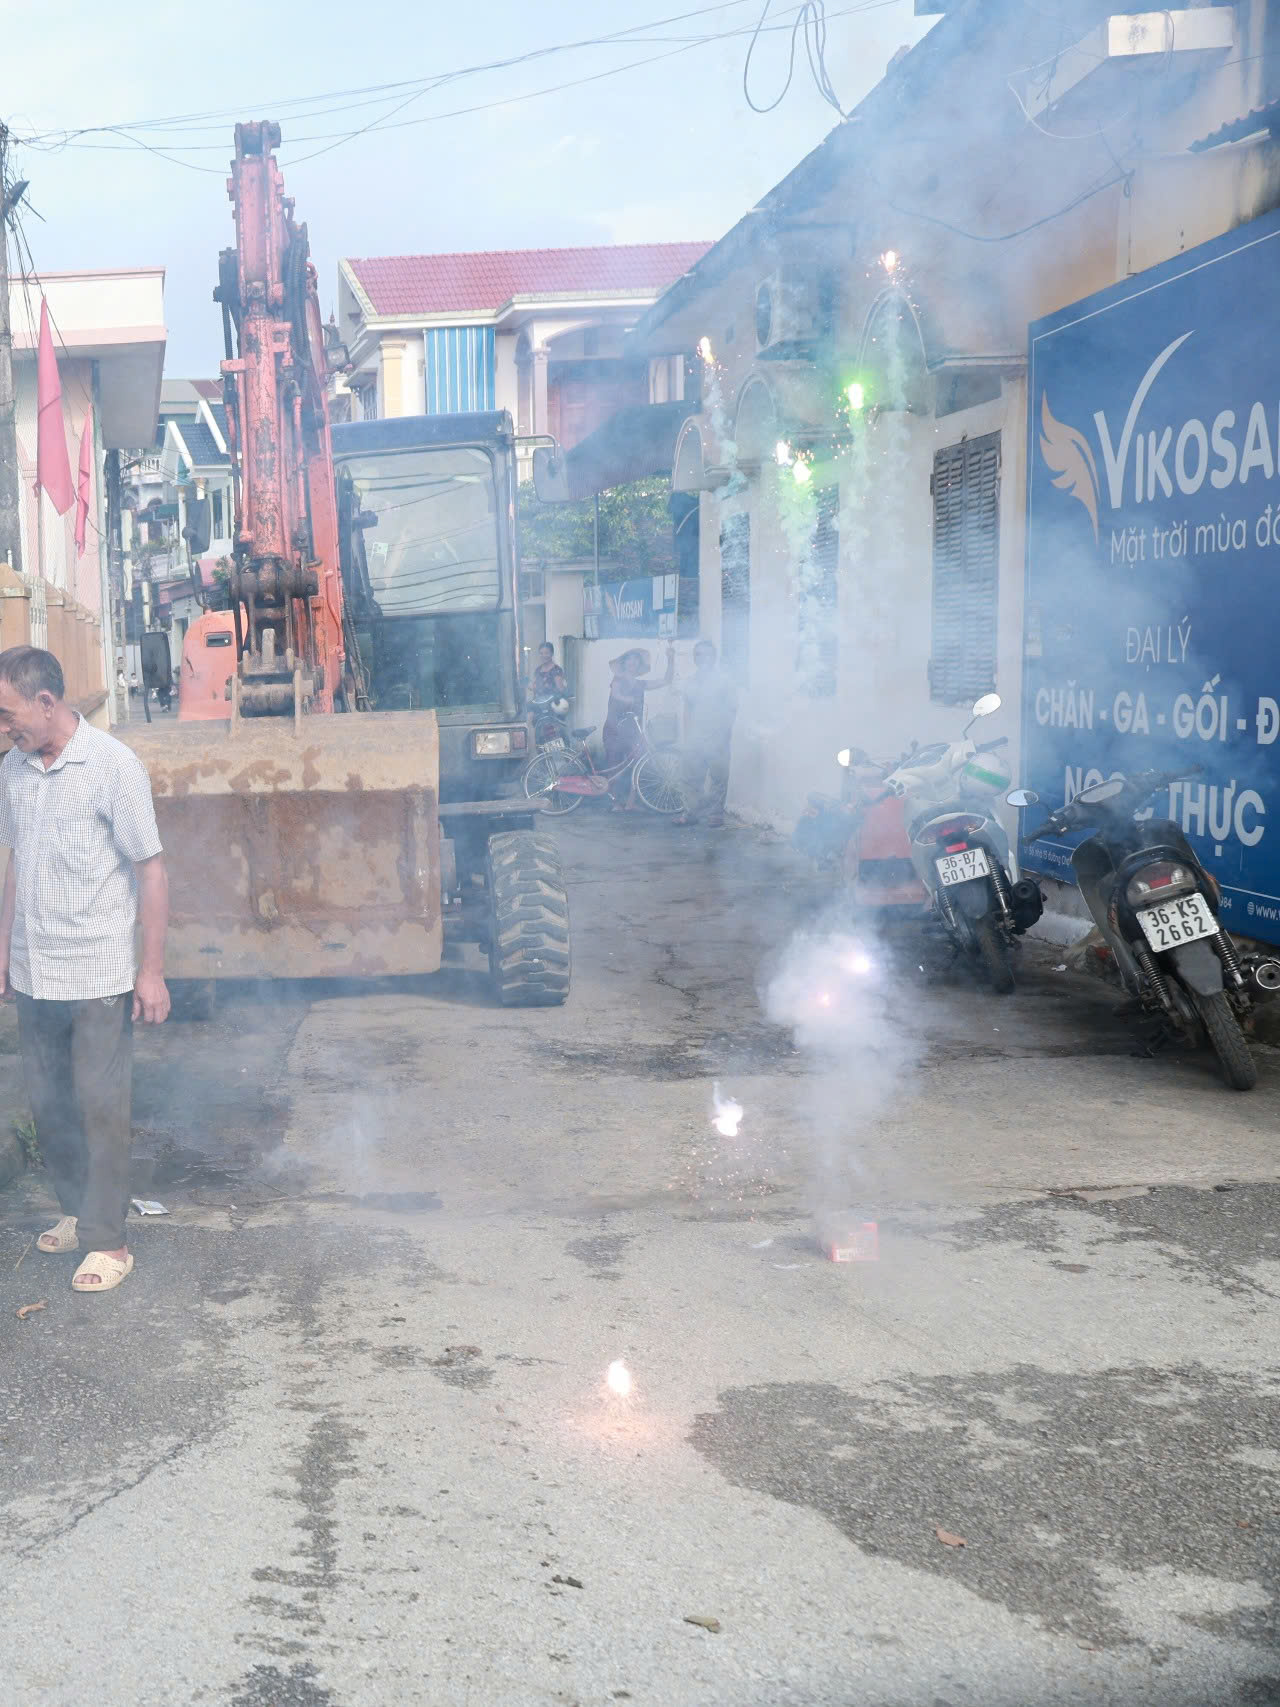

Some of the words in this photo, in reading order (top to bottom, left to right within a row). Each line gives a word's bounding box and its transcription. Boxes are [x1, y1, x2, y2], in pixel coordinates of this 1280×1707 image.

[1111, 526, 1146, 569] Mặt
[1152, 520, 1188, 560] trời
[1195, 512, 1247, 555] mùa
[1126, 626, 1161, 672] ĐẠI
[1167, 615, 1192, 664] LÝ
[1035, 680, 1094, 730] CHĂN
[1113, 691, 1150, 734] GA
[1173, 673, 1228, 742] GỐI
[942, 851, 976, 870] 36-B7
[942, 862, 986, 883] 501.71
[1148, 898, 1199, 927] 36-K5
[1157, 916, 1208, 945] 2662
